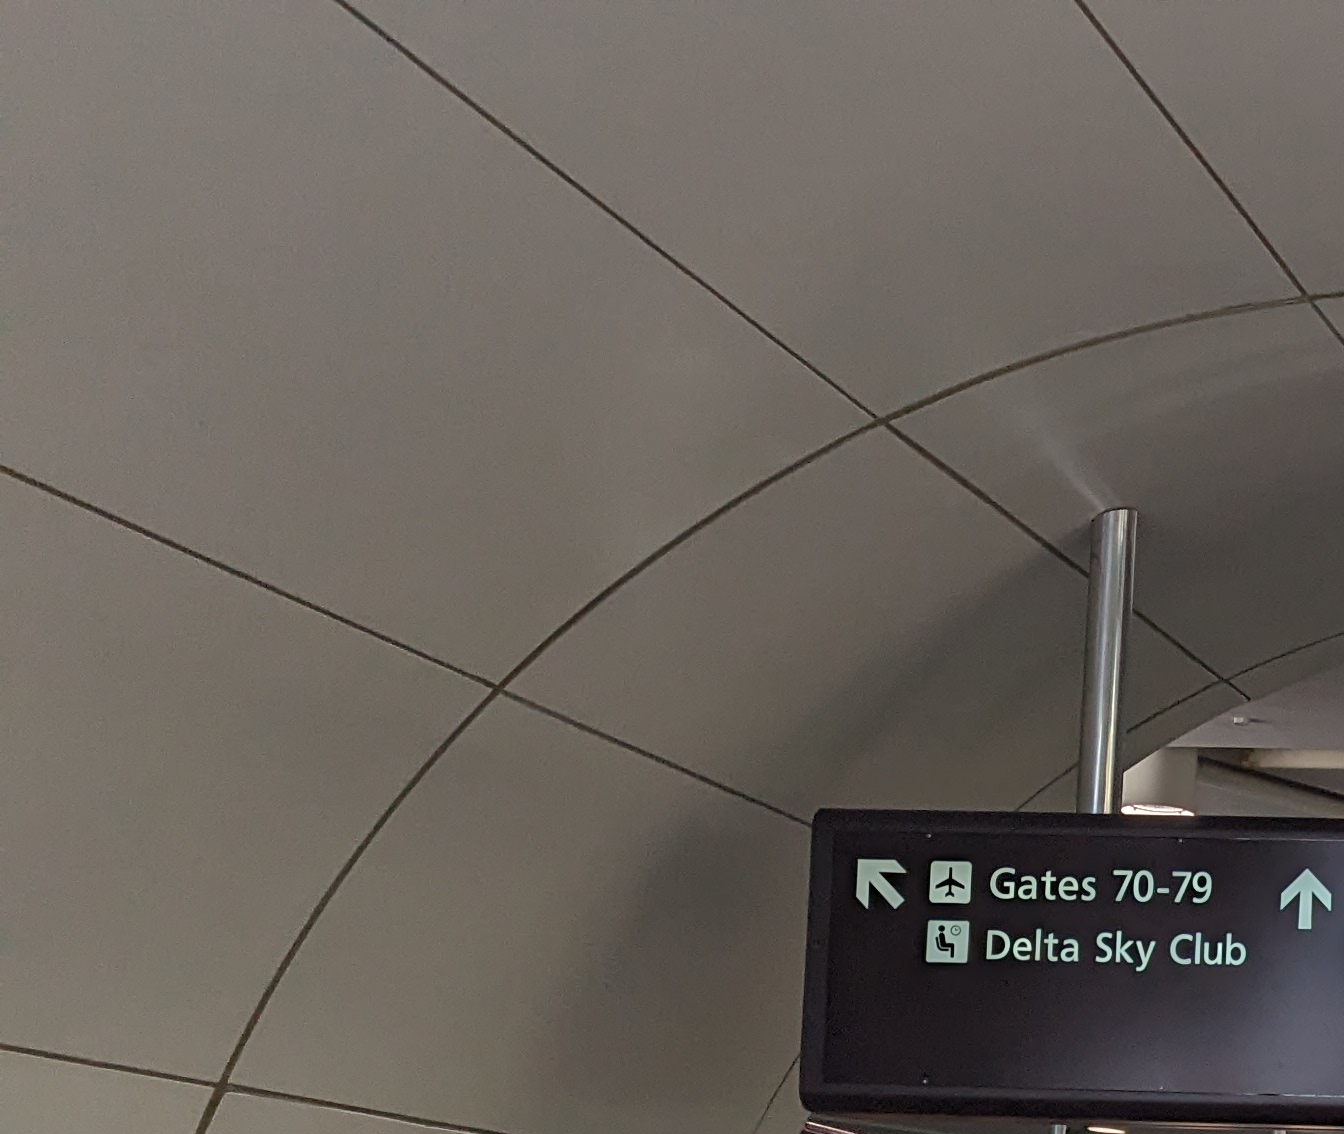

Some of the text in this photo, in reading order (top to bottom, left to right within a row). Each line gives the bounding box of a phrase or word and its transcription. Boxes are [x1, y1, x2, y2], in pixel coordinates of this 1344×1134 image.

[990, 867, 1213, 904] Gates 70-79
[985, 928, 1247, 972] Delta Sky Club
